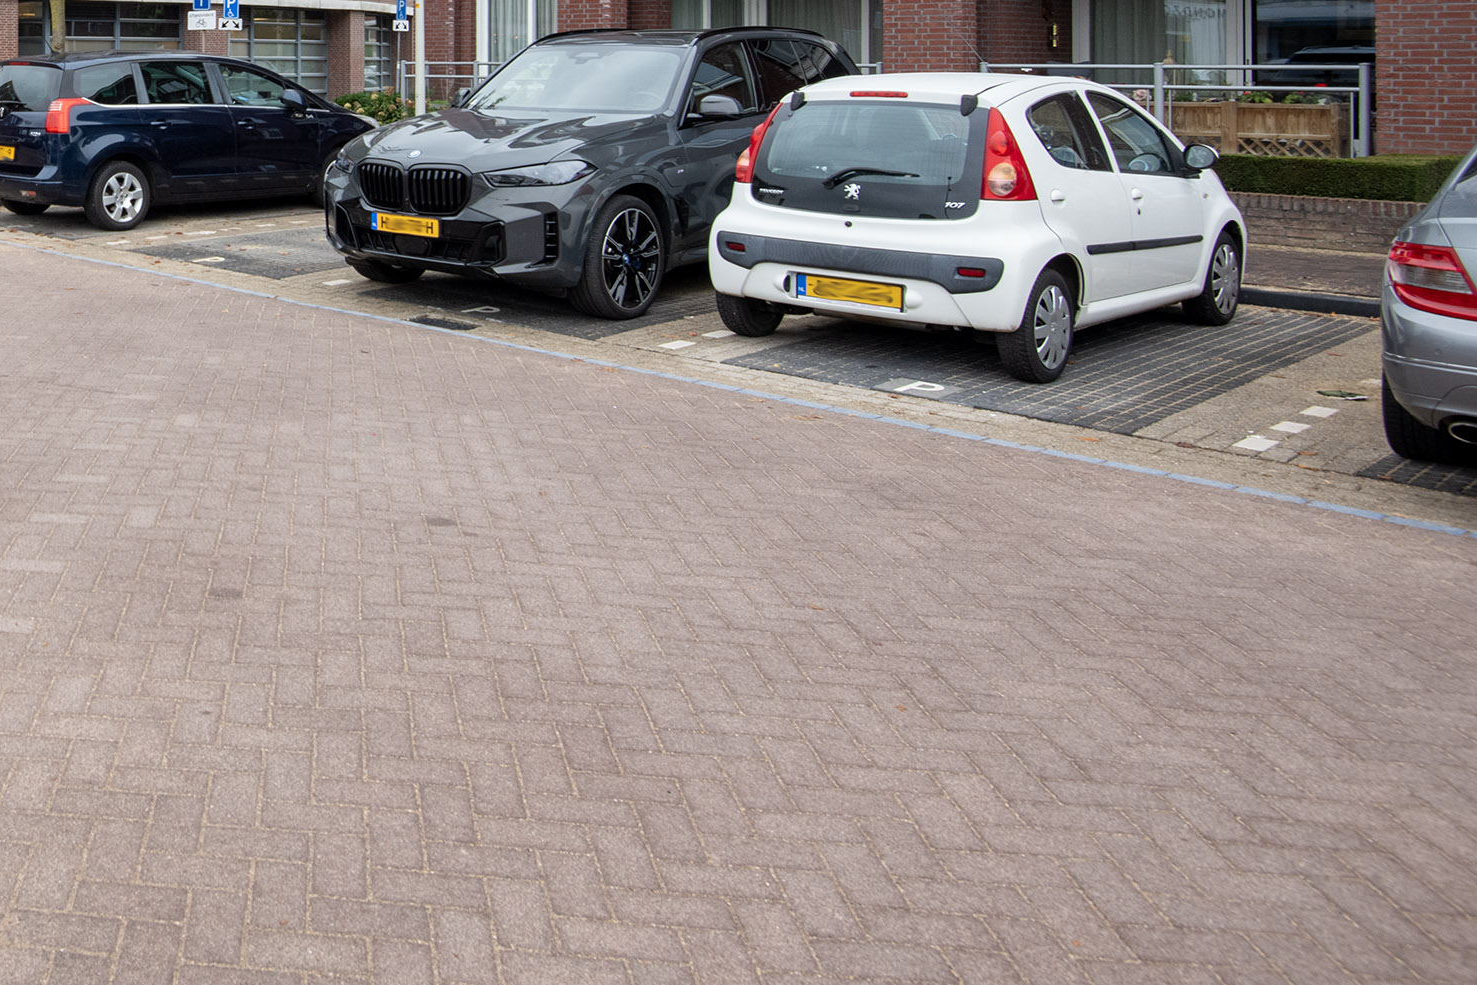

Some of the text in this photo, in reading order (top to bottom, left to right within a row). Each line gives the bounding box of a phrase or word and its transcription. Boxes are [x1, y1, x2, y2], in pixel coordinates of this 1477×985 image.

[399, 0, 405, 11] P
[944, 201, 966, 209] 107
[460, 305, 501, 313] P
[893, 381, 945, 392] P
